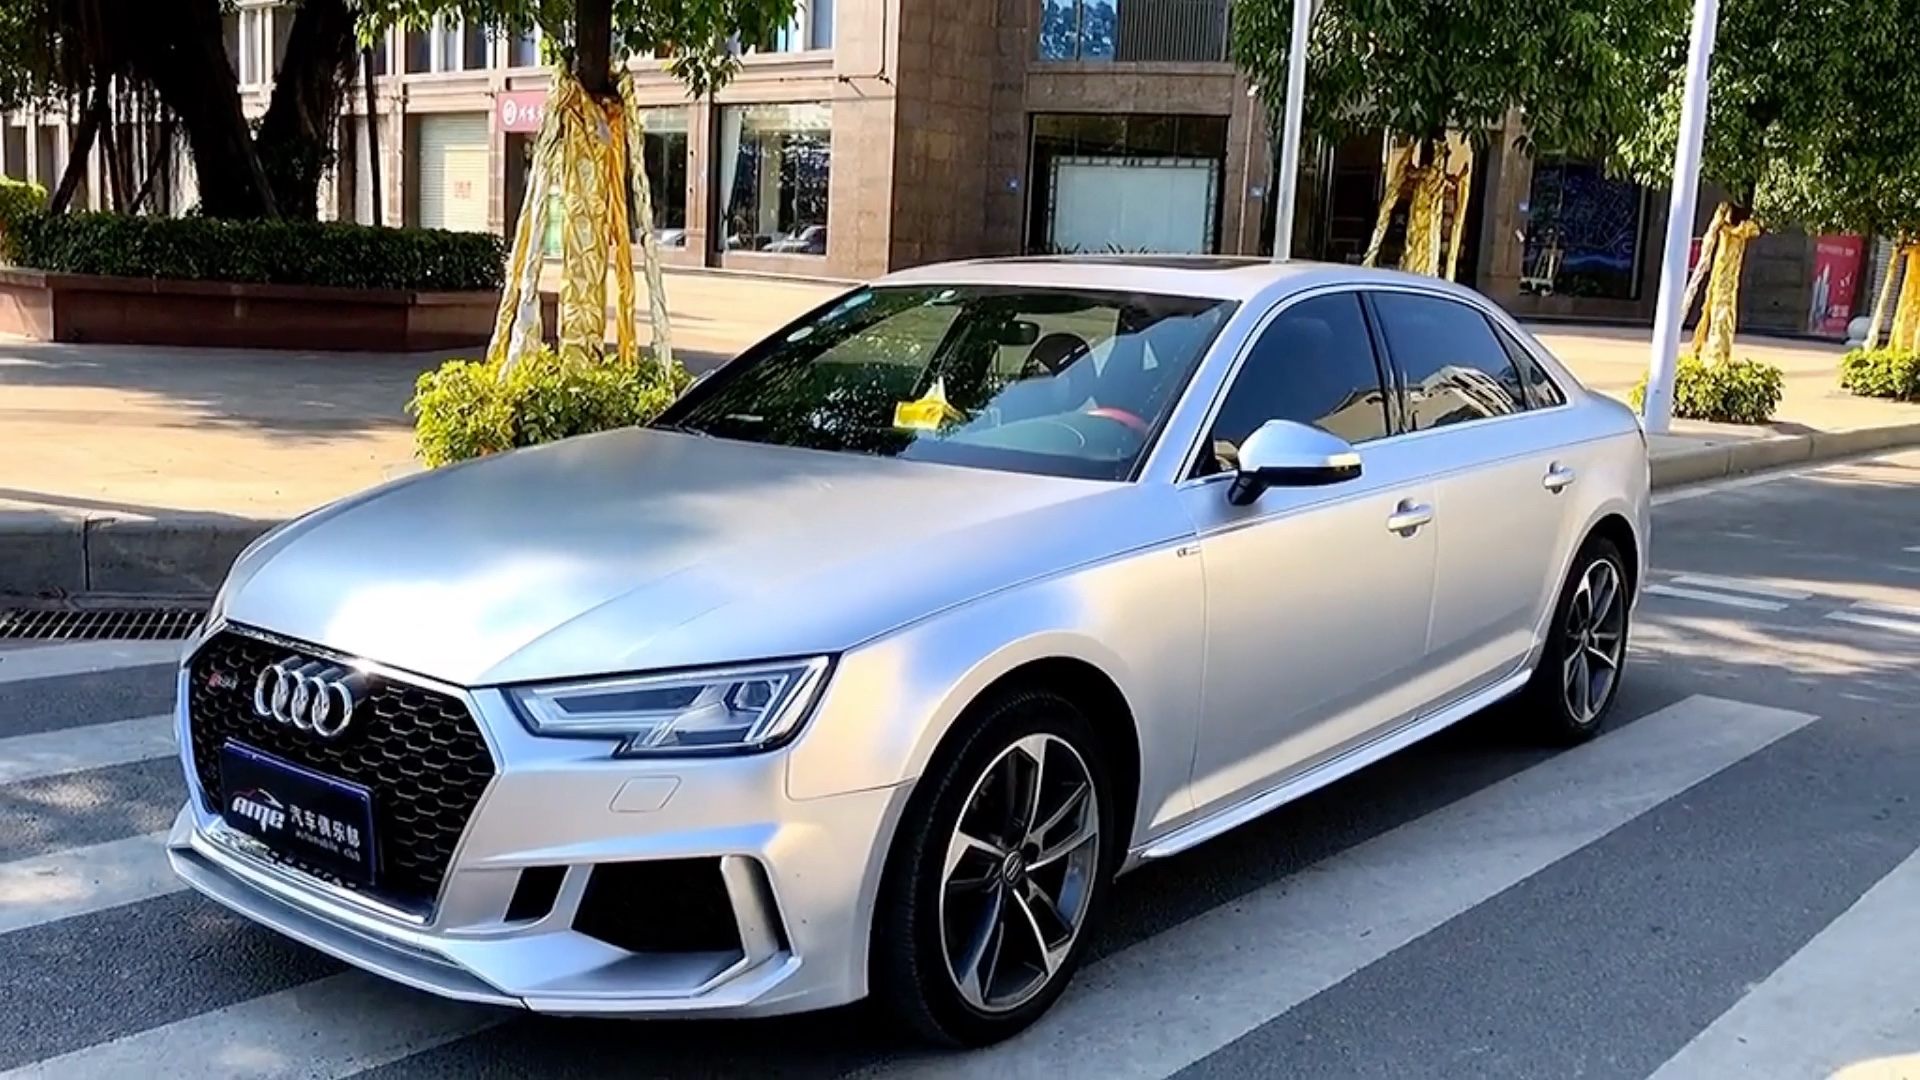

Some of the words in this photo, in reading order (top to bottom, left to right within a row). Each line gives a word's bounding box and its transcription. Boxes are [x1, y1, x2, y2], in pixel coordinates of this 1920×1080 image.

[289, 804, 360, 848] 汽车俱乐部
